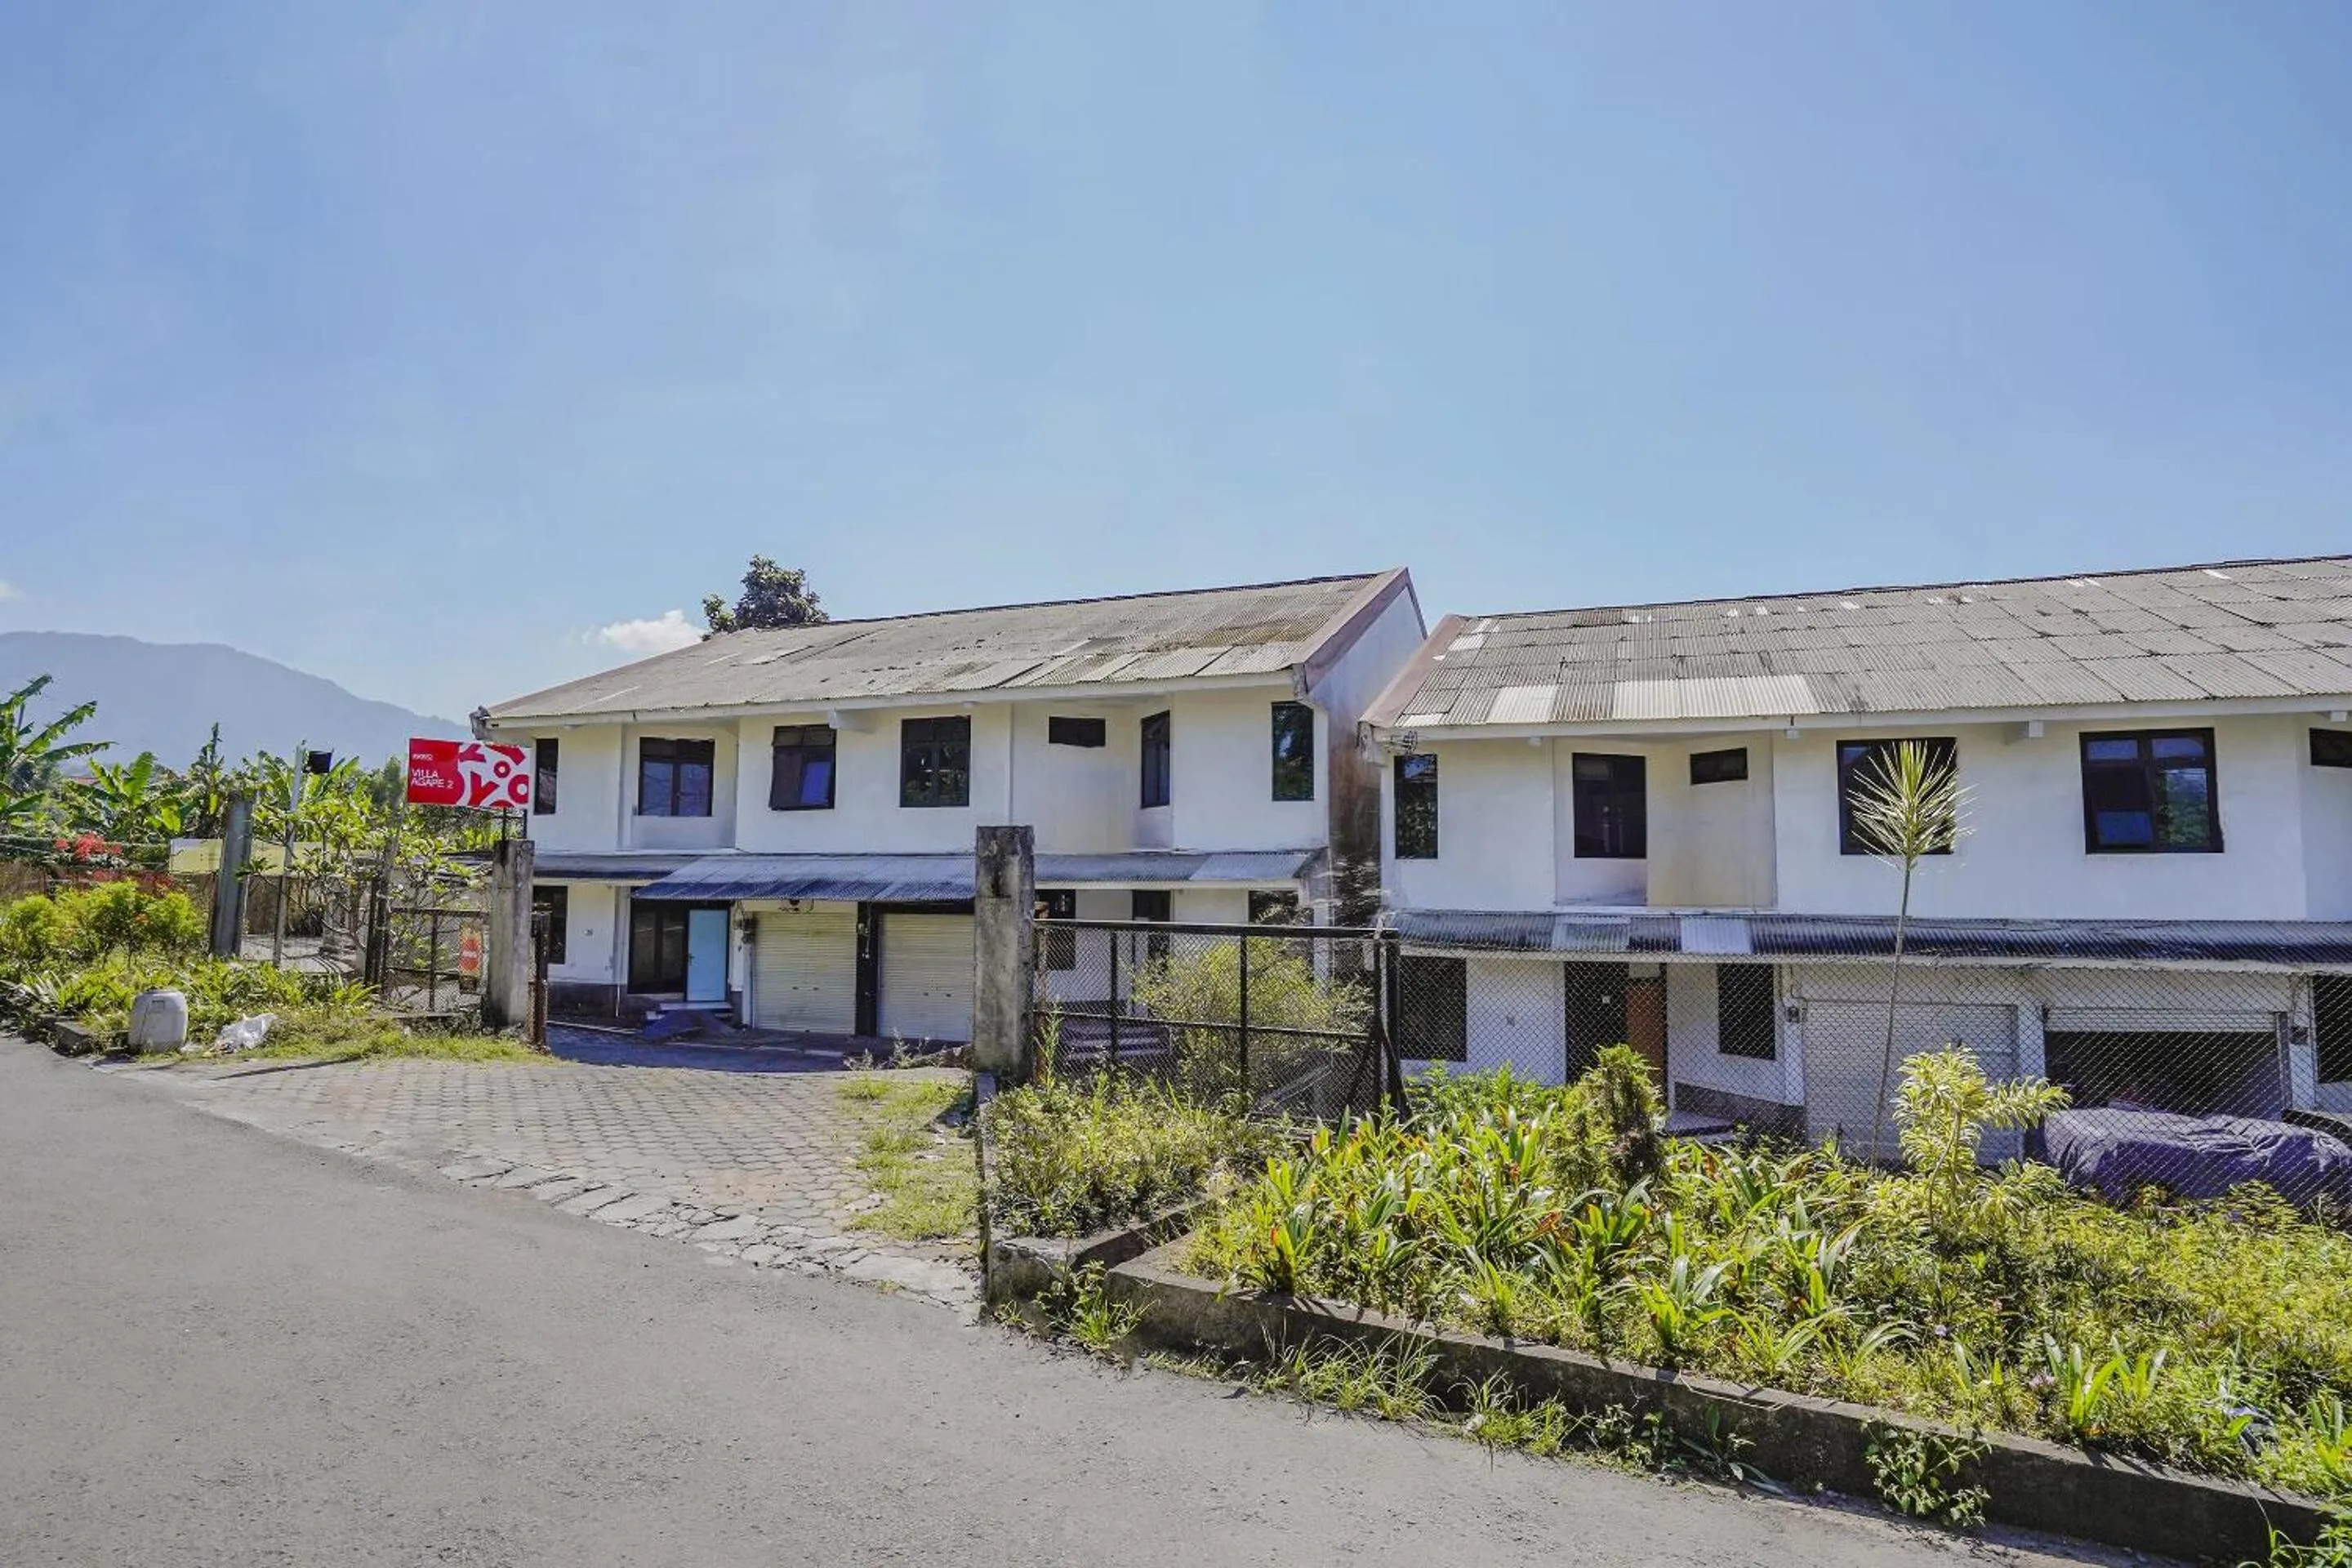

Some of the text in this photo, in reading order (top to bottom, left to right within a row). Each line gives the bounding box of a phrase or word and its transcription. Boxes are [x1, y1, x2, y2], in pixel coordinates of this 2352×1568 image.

[412, 768, 439, 778] VILLA
[411, 777, 455, 789] AGAPE 2
